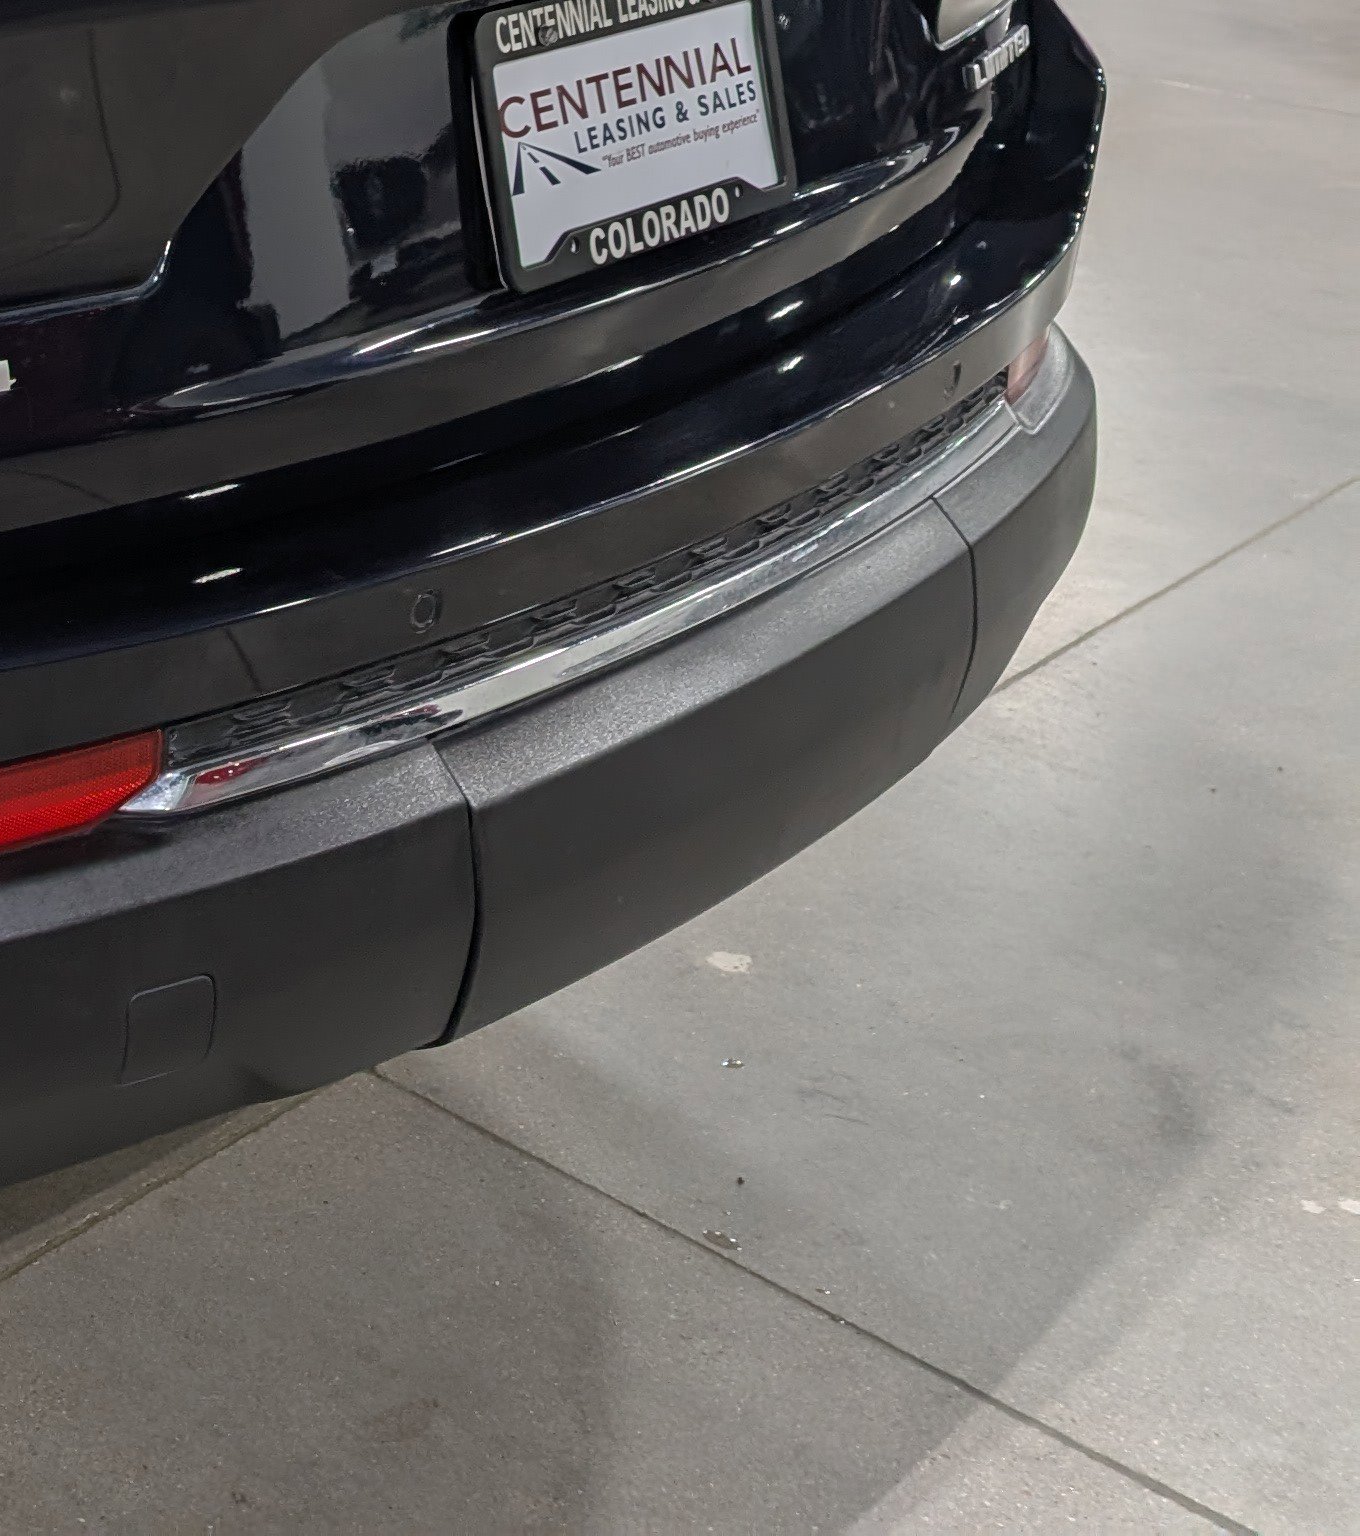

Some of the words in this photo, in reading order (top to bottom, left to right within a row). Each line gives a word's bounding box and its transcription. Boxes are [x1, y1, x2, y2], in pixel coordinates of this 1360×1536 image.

[497, 37, 752, 139] CENTENNIAL
[573, 106, 666, 154] LEASING
[675, 101, 689, 123] &
[697, 80, 757, 117] SALES
[626, 143, 646, 163] BEST
[648, 133, 692, 155] automotive
[693, 124, 720, 143] buying
[588, 187, 730, 265] COLORADO
